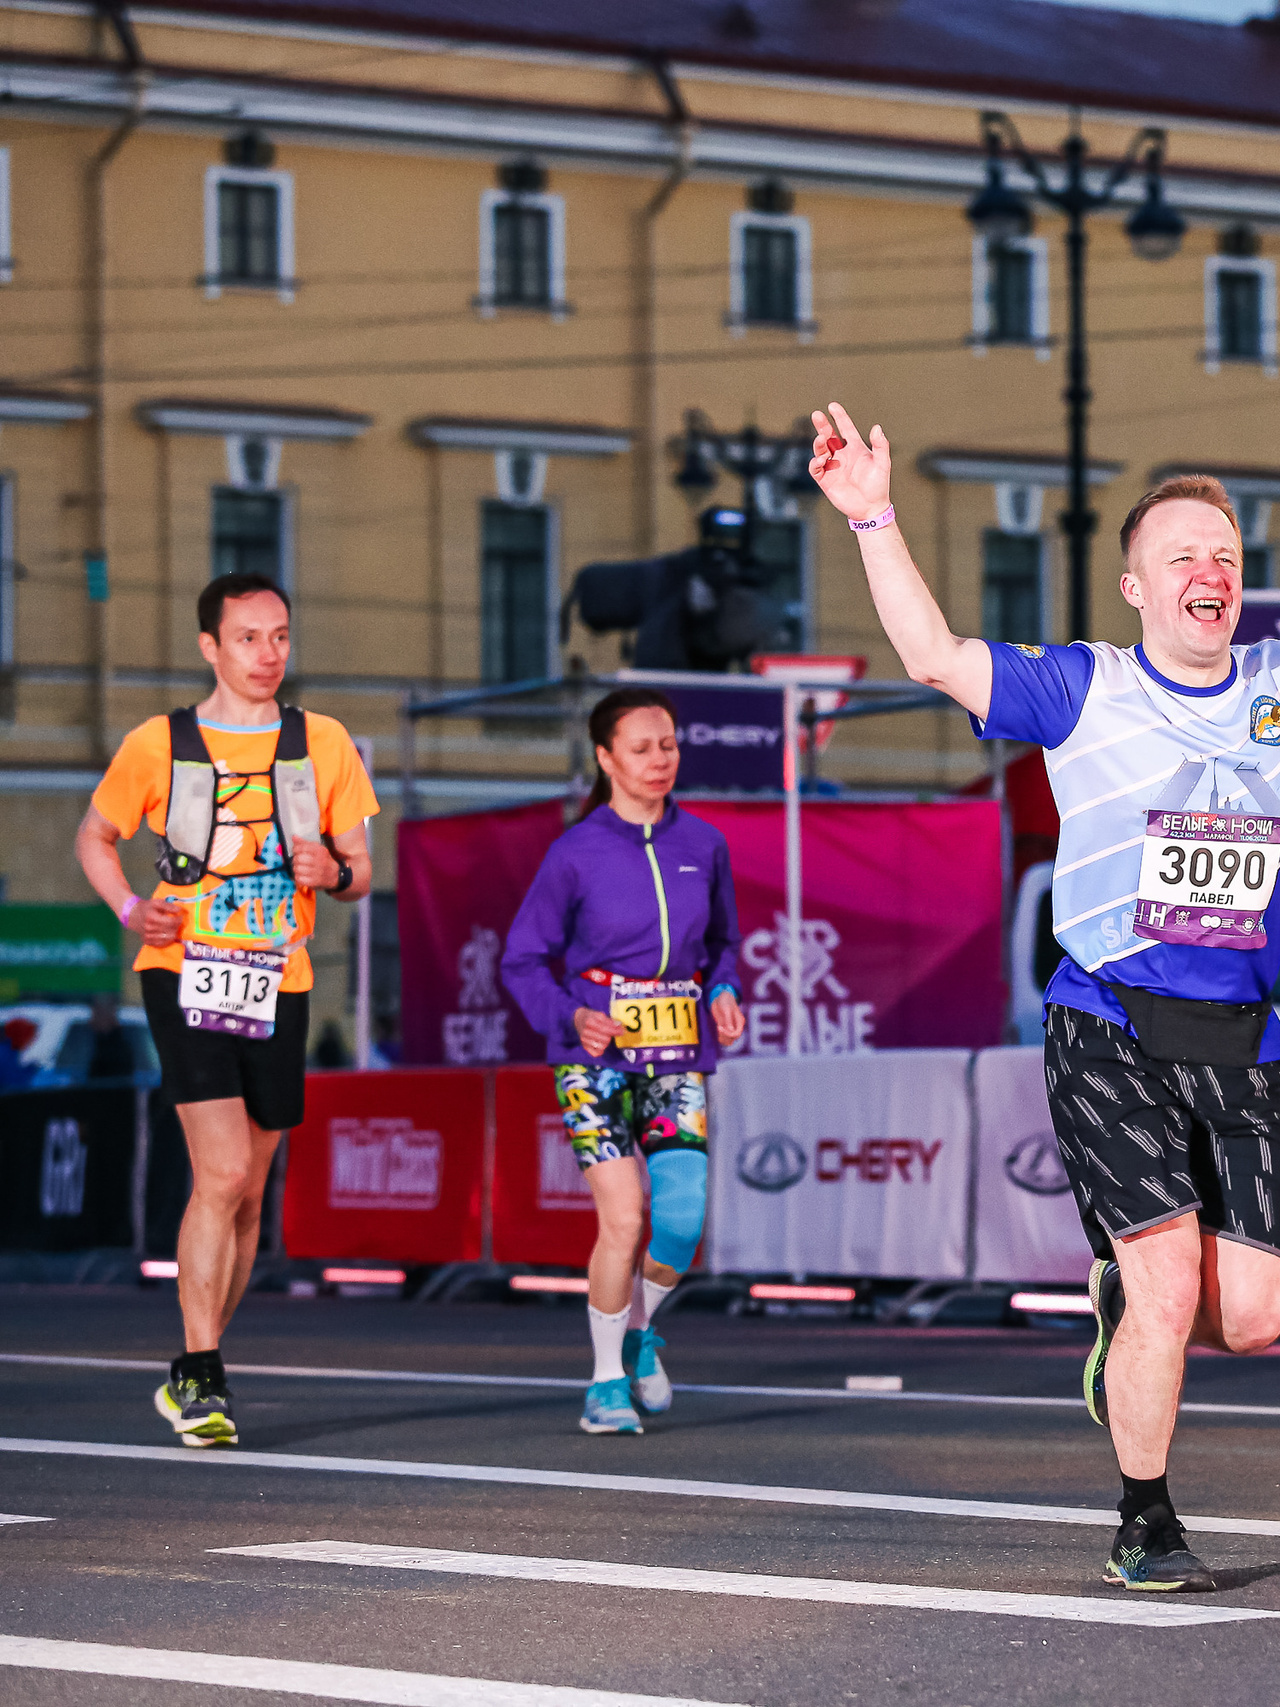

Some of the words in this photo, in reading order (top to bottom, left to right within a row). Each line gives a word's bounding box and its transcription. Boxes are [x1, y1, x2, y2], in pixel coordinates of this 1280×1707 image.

[852, 520, 877, 529] 3090
[1162, 814, 1209, 832] БЕЛЫЕ
[1231, 817, 1273, 835] НОЧИ
[1159, 846, 1266, 890] 3090
[1189, 892, 1234, 905] ПАВЕЛ
[195, 967, 270, 1003] 3113
[188, 1008, 203, 1027] D
[625, 1003, 692, 1033] 3111
[815, 1138, 943, 1184] CHERY
